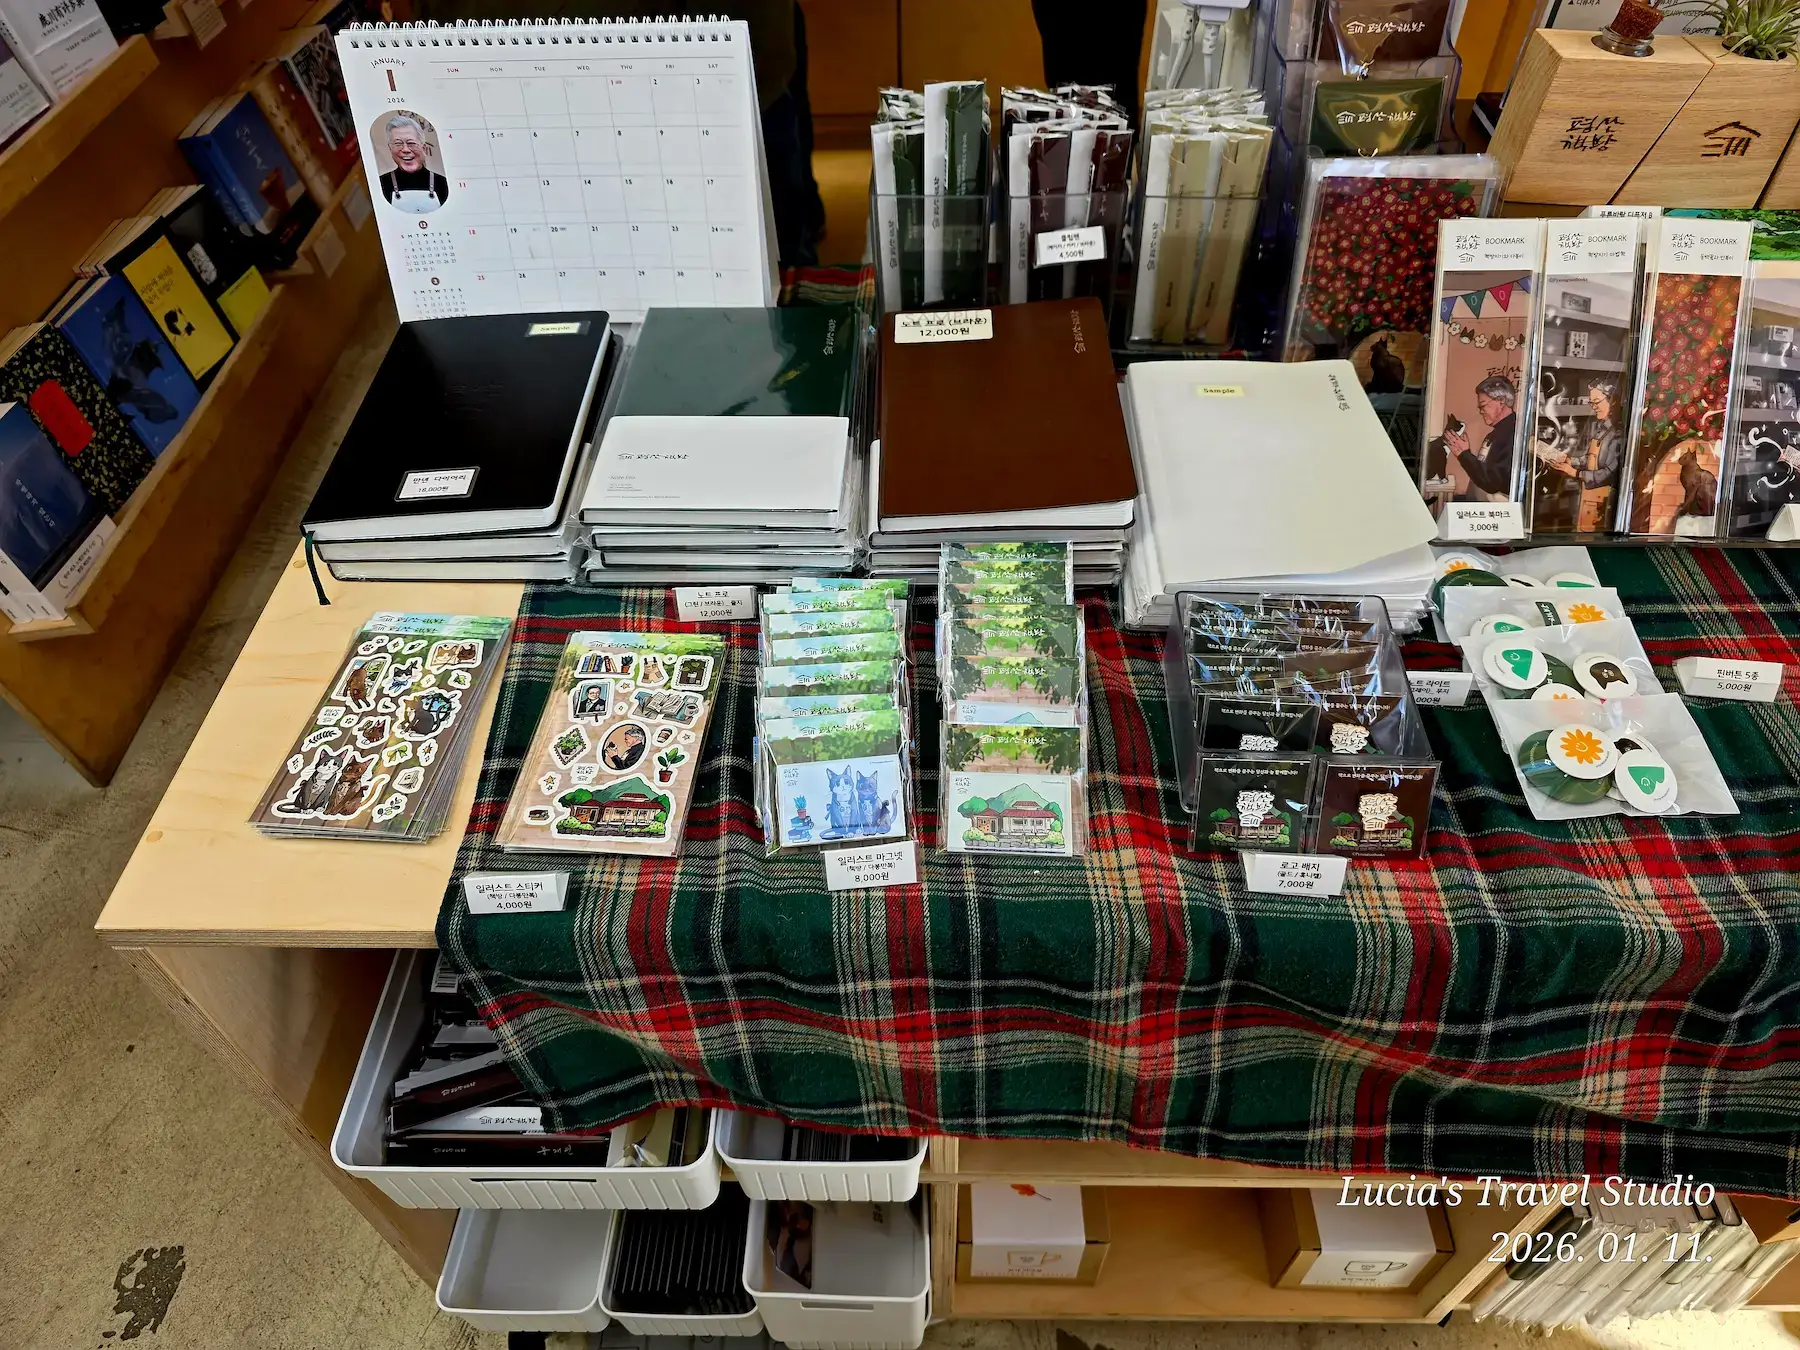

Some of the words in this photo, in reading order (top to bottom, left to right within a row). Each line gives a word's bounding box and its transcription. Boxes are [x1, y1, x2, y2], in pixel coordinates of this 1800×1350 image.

[371, 57, 407, 68] JANUARY
[1565, 116, 1625, 133] 평산
[1560, 133, 1618, 152] 책방
[1061, 233, 1080, 241] 클립펜
[1456, 234, 1481, 244] 평산
[1485, 237, 1525, 245] BOOKMARK
[1558, 232, 1583, 242] 평산
[1588, 235, 1628, 243] BOOKMARK
[1672, 234, 1696, 242] 평산
[1455, 242, 1480, 250] 책방
[1558, 240, 1583, 248] 책방
[1059, 250, 1084, 259] 4,500원
[900, 319, 922, 327] 노트
[925, 318, 945, 326] 프로
[948, 317, 988, 326] (브라운)
[920, 328, 970, 337] 12,000원
[434, 474, 466, 482] 다이어리
[1456, 510, 1487, 520] 일러스트
[1488, 510, 1510, 518] 북마크
[1469, 522, 1499, 532] 3,000원
[700, 609, 732, 617] 12,000원
[1717, 669, 1742, 679] 핀버튼
[1745, 671, 1760, 680] 5종
[1426, 680, 1450, 688] 라이트
[1717, 682, 1753, 692] 5,000원
[838, 854, 874, 866] 일러스트
[876, 852, 903, 862] 마그넷
[1280, 861, 1298, 869] 로고
[1301, 862, 1320, 871] 배지
[855, 873, 890, 883] 8,000원
[476, 884, 514, 894] 일러스트
[516, 882, 544, 891] 스티커
[1278, 880, 1314, 890] 7,000원
[496, 901, 532, 910] 4,000원
